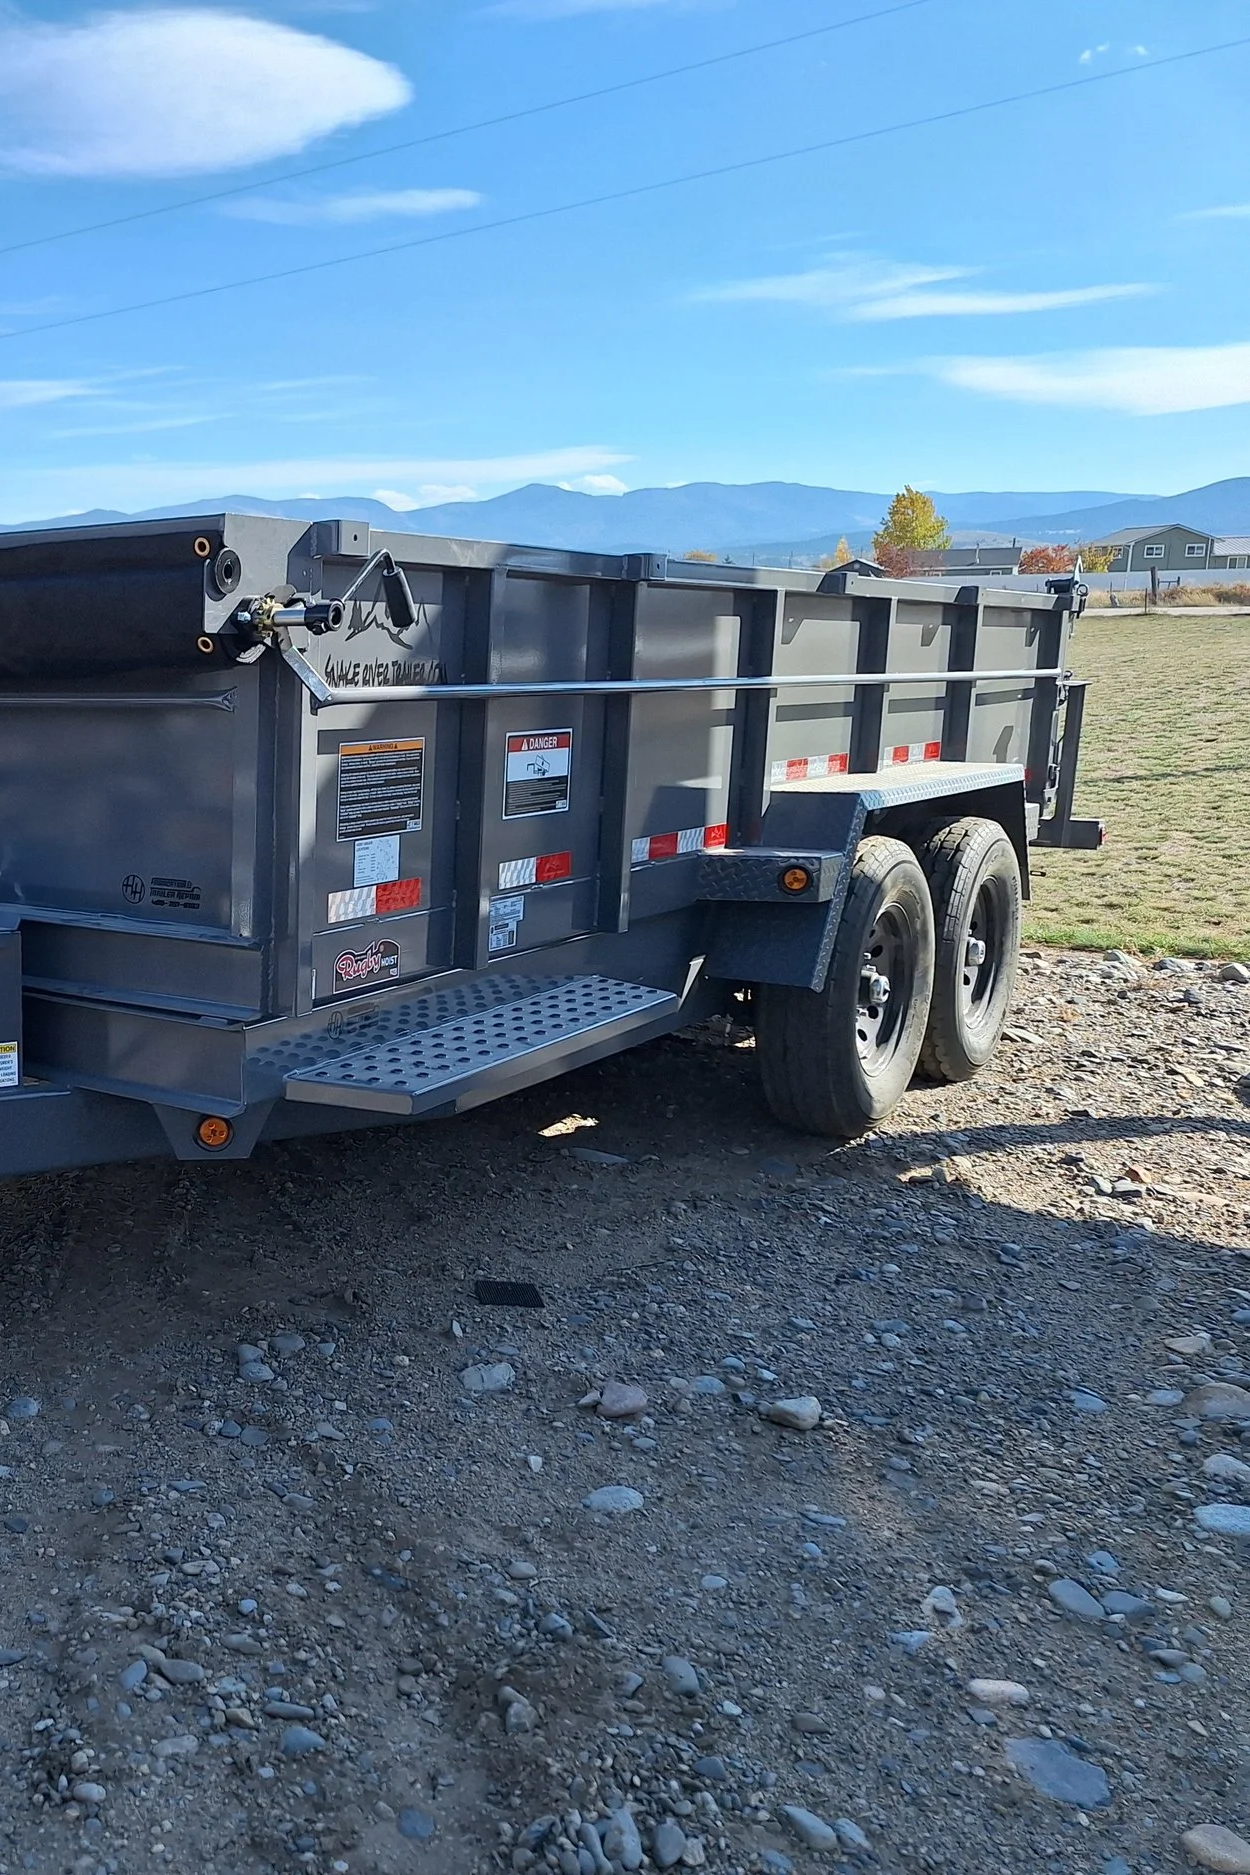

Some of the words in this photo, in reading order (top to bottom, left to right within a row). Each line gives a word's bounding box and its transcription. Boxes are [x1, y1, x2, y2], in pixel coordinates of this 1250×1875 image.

[325, 654, 361, 688] SNAKE
[362, 657, 390, 687] RIVER
[373, 743, 394, 751] WARNING
[529, 736, 558, 749] DANGER
[337, 949, 382, 981] Rugby
[381, 955, 398, 967] HOIST
